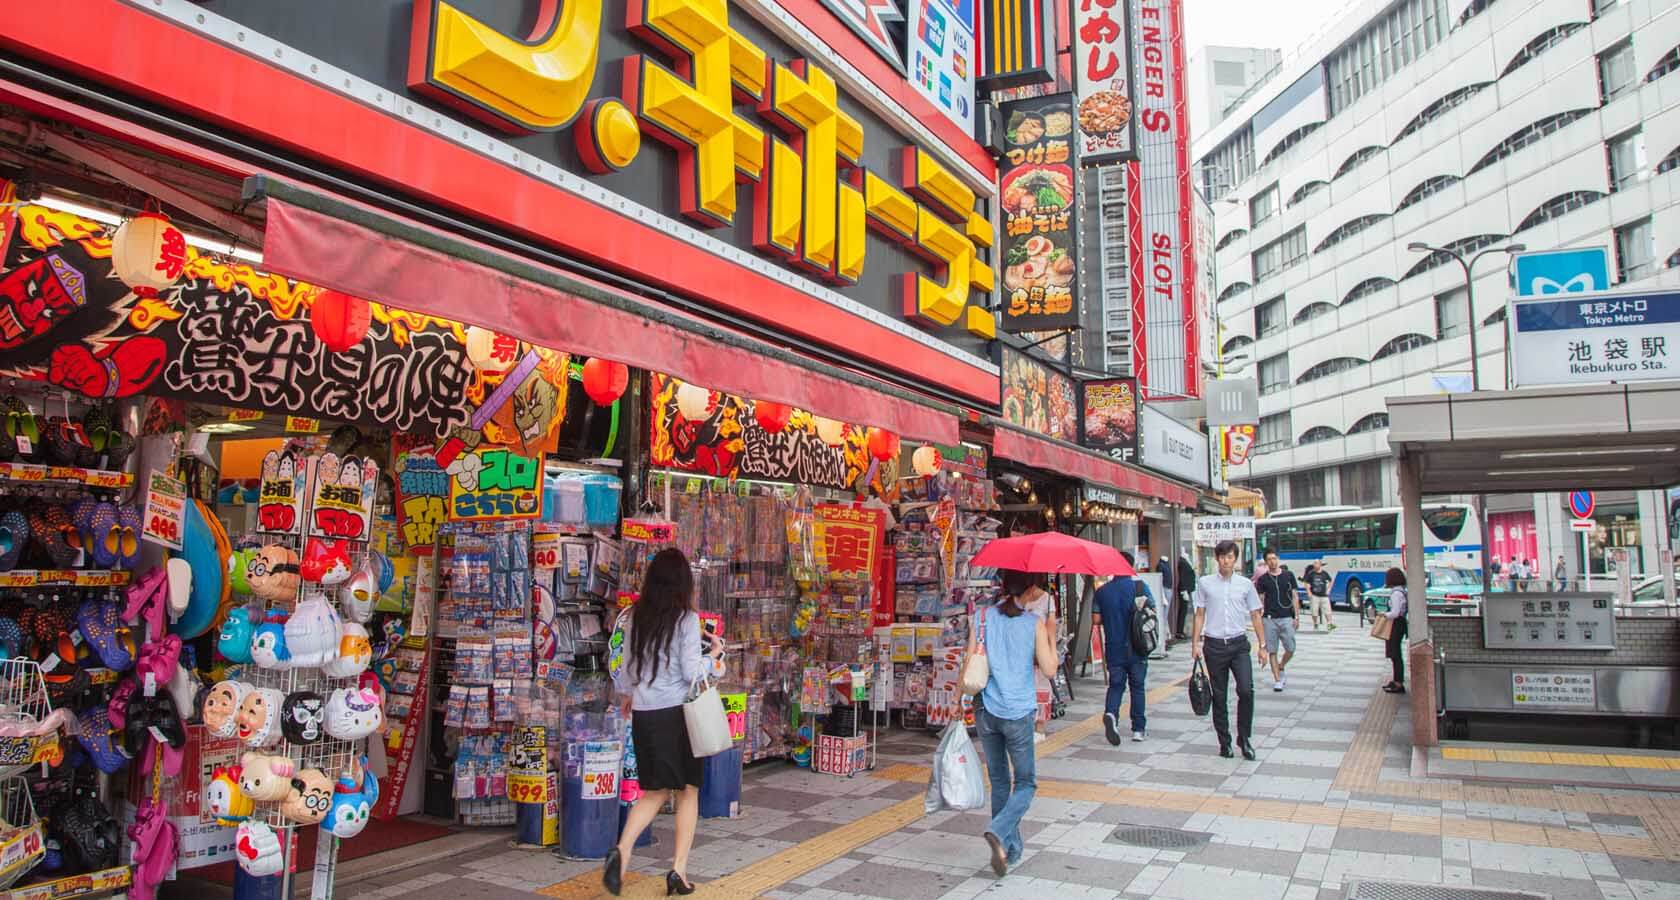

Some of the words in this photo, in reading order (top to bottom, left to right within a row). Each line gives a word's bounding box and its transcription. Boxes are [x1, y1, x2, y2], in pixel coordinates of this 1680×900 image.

[953, 27, 968, 54] VISA
[1006, 140, 1070, 165] つけ麺
[1006, 210, 1069, 237] 油そば
[1152, 233, 1172, 301] SLOT
[1579, 299, 1648, 315] 東京メトロ
[1585, 315, 1613, 325] Tokyo
[1615, 313, 1644, 323] Metro
[1568, 336, 1667, 362] 池袋駅
[1570, 362, 1638, 375] Ikebukuro
[1641, 359, 1667, 371] Sta.
[1111, 447, 1134, 460] 2F
[262, 480, 292, 497] お面
[320, 485, 361, 505] お面
[403, 495, 448, 523] TA
[456, 493, 514, 516] こちら
[151, 515, 178, 541] 999
[1522, 601, 1570, 612] 池袋駅
[595, 772, 614, 795] 398
